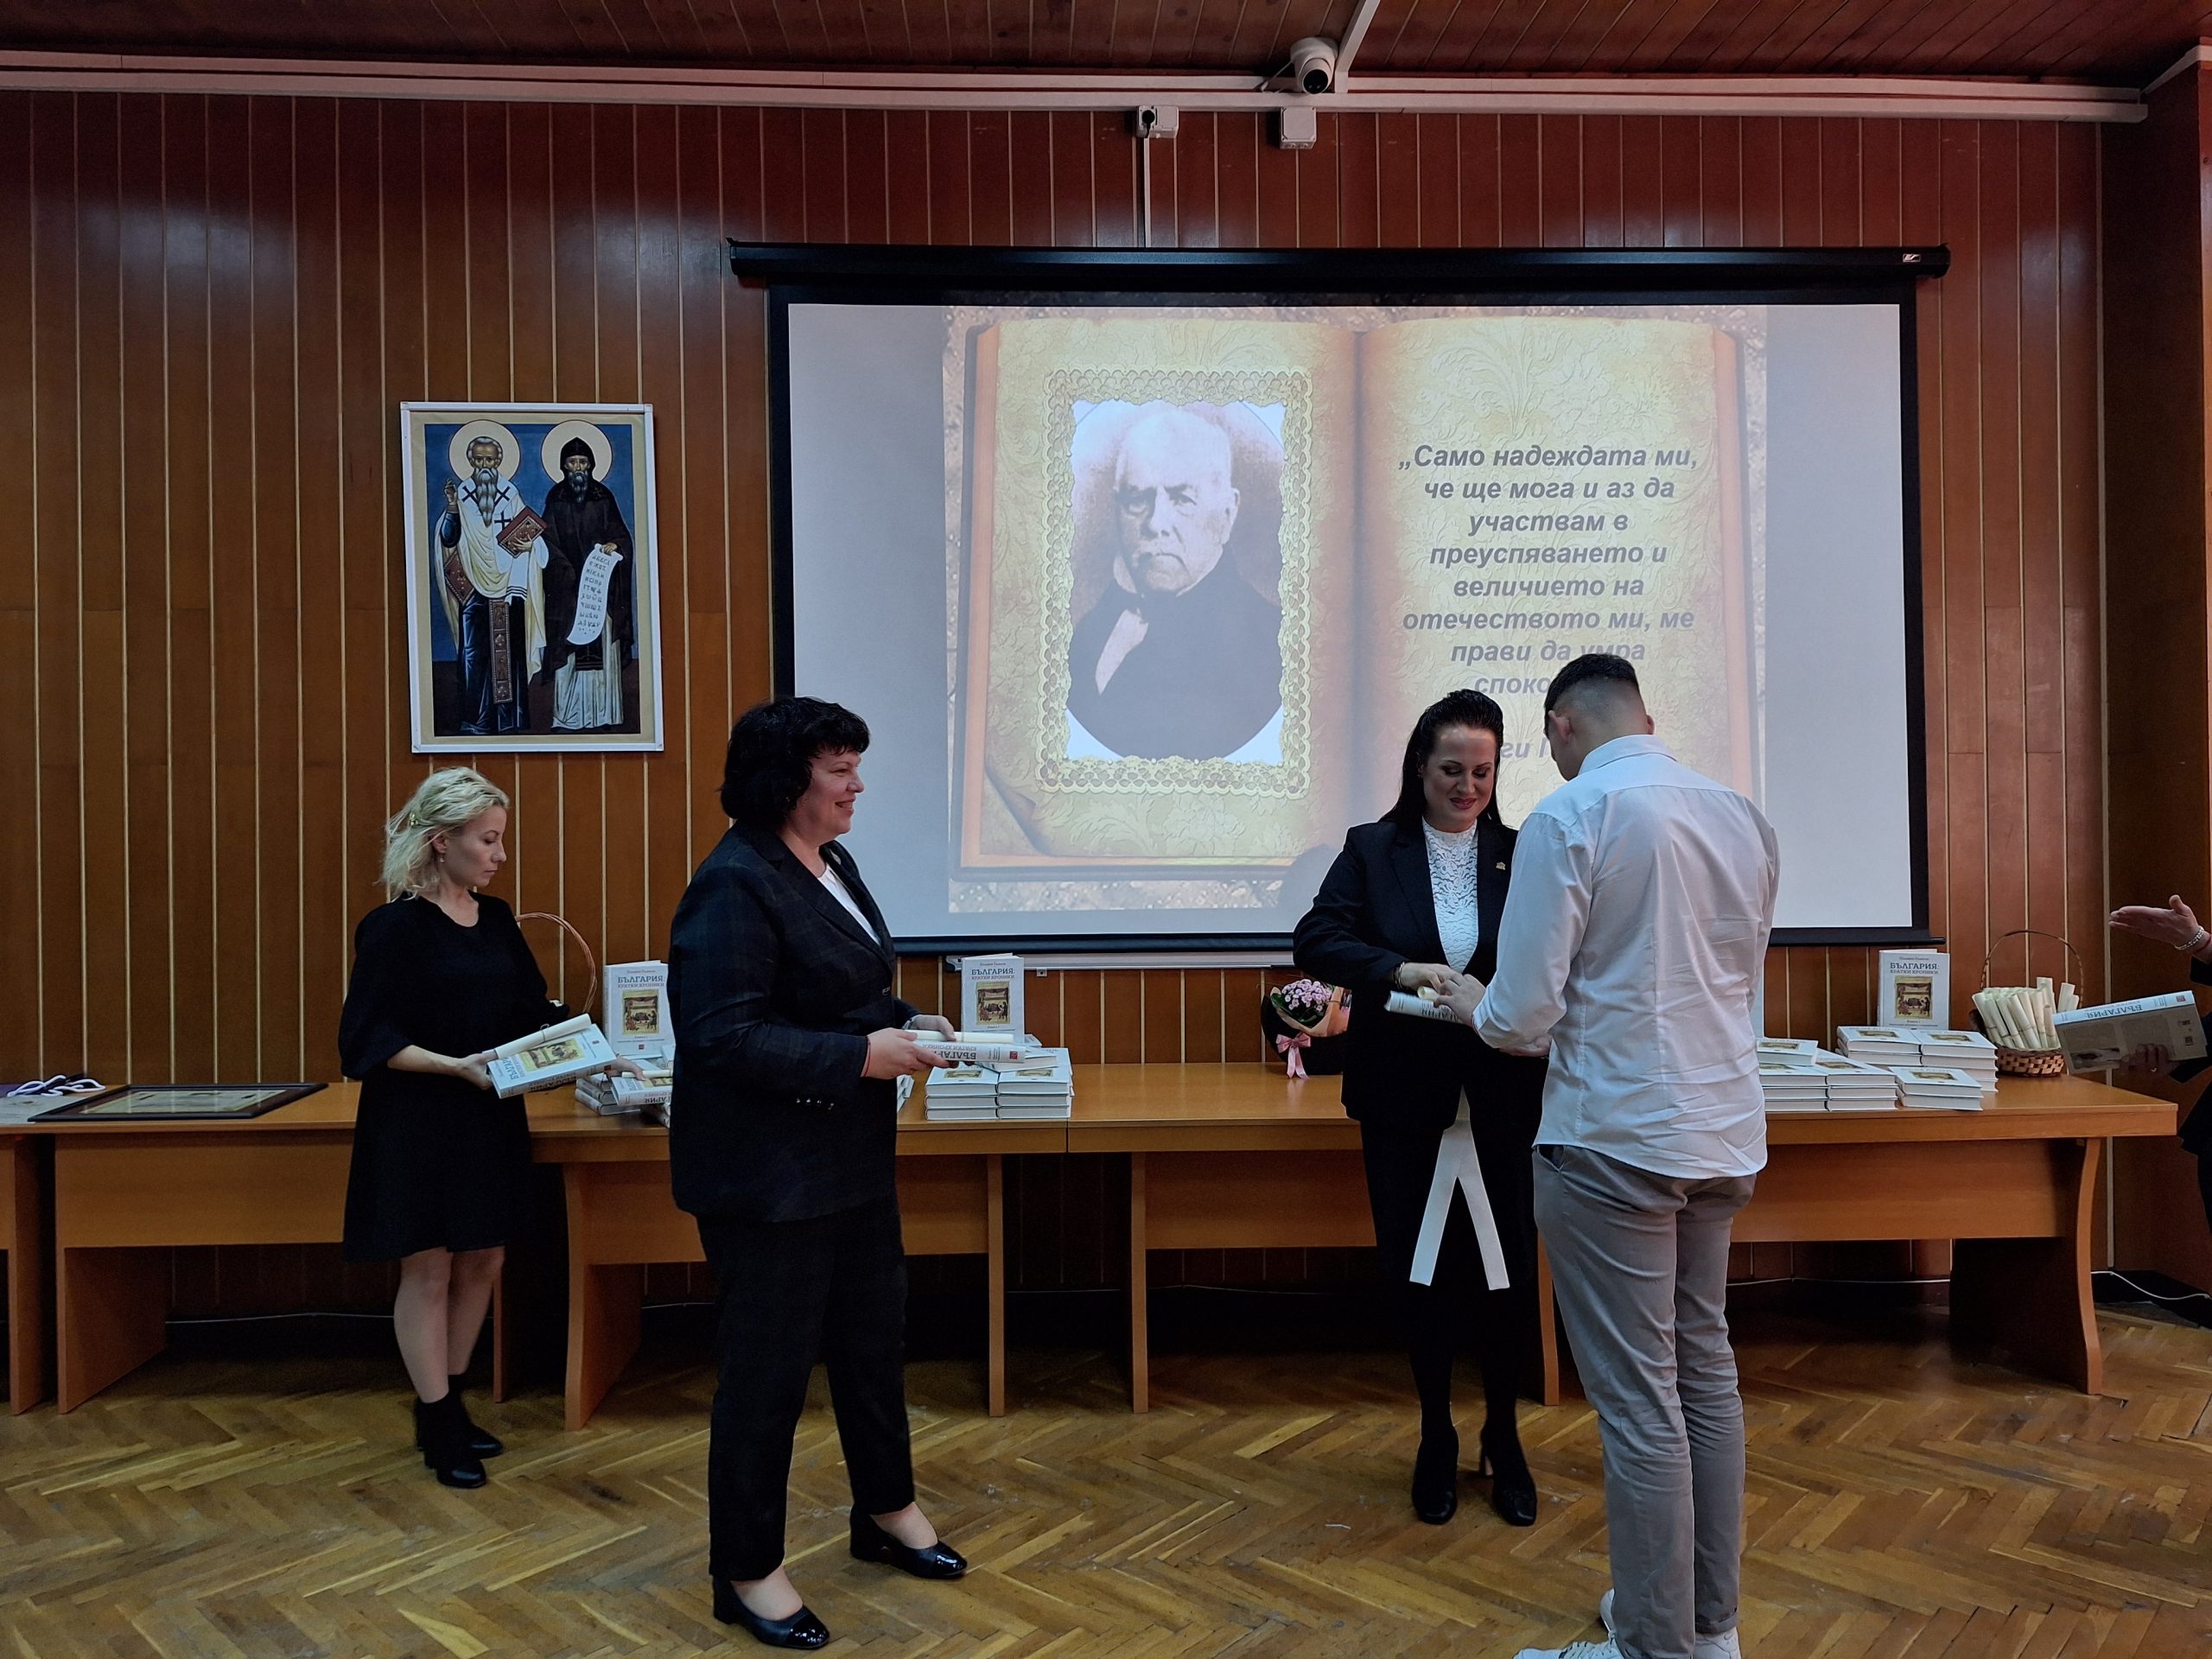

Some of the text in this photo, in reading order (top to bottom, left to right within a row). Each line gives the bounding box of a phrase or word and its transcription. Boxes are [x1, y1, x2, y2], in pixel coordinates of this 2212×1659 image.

[1398, 444, 1698, 470] „Само надеждата ми,
[1424, 477, 1675, 502] че ще мога и аз да
[1468, 512, 1629, 536] участвам в
[1430, 545, 1667, 569] преуспяването и
[1452, 578, 1644, 598] величието на
[1402, 610, 1695, 633] отечеството ми, ме
[1450, 644, 1531, 666] прави
[1540, 639, 1571, 661] да
[2087, 1004, 2143, 1019] БЪЛГАРИЯ
